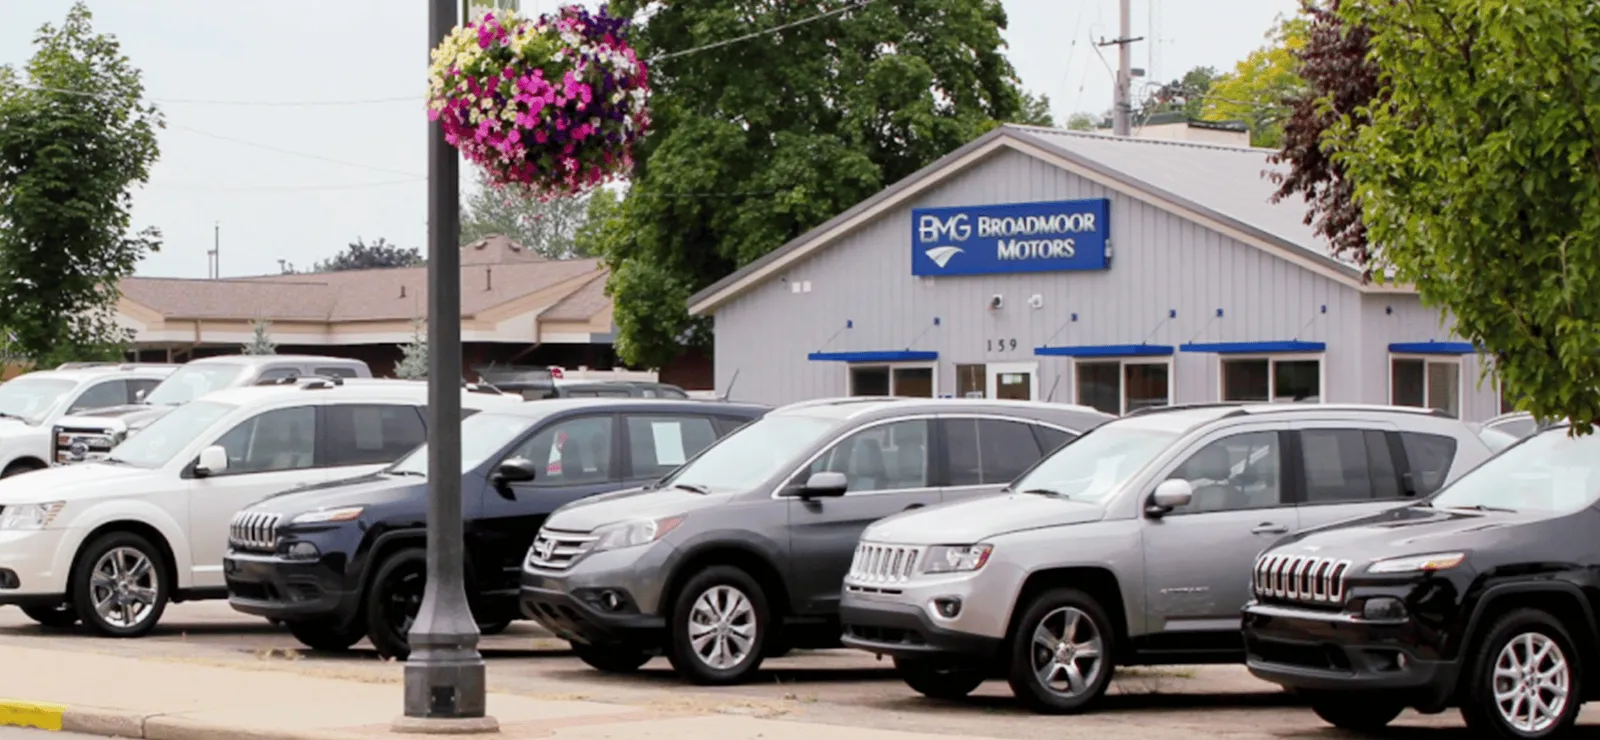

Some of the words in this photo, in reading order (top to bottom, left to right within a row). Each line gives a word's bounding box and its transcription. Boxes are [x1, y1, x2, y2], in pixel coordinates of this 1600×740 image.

[919, 213, 971, 242] BMG
[978, 213, 1096, 237] BROADMOOR
[997, 238, 1075, 260] MOTORS
[987, 338, 1017, 352] 159
